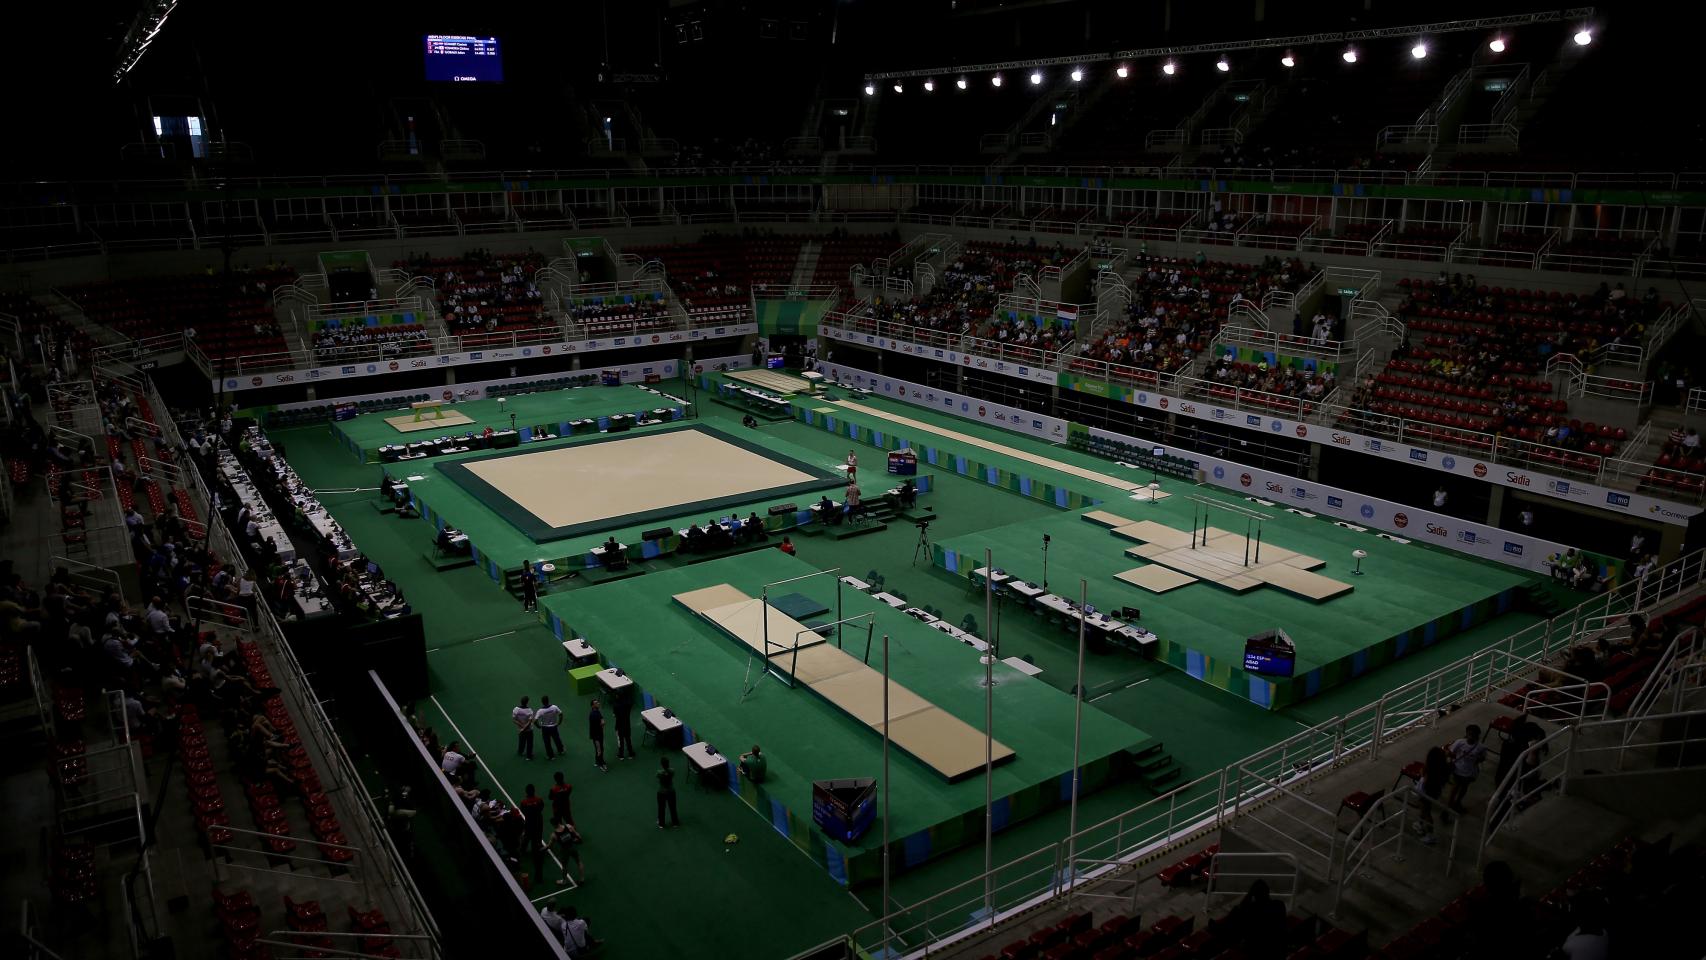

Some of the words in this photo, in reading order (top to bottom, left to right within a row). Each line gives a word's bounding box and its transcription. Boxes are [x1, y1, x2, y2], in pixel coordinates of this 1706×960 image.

[276, 374, 294, 383] Sadia
[1180, 403, 1196, 414] Sadia
[1331, 433, 1351, 446] Sadia
[1506, 471, 1531, 487] Sadia
[1265, 481, 1283, 494] Sadia
[1426, 522, 1448, 537] Sadia
